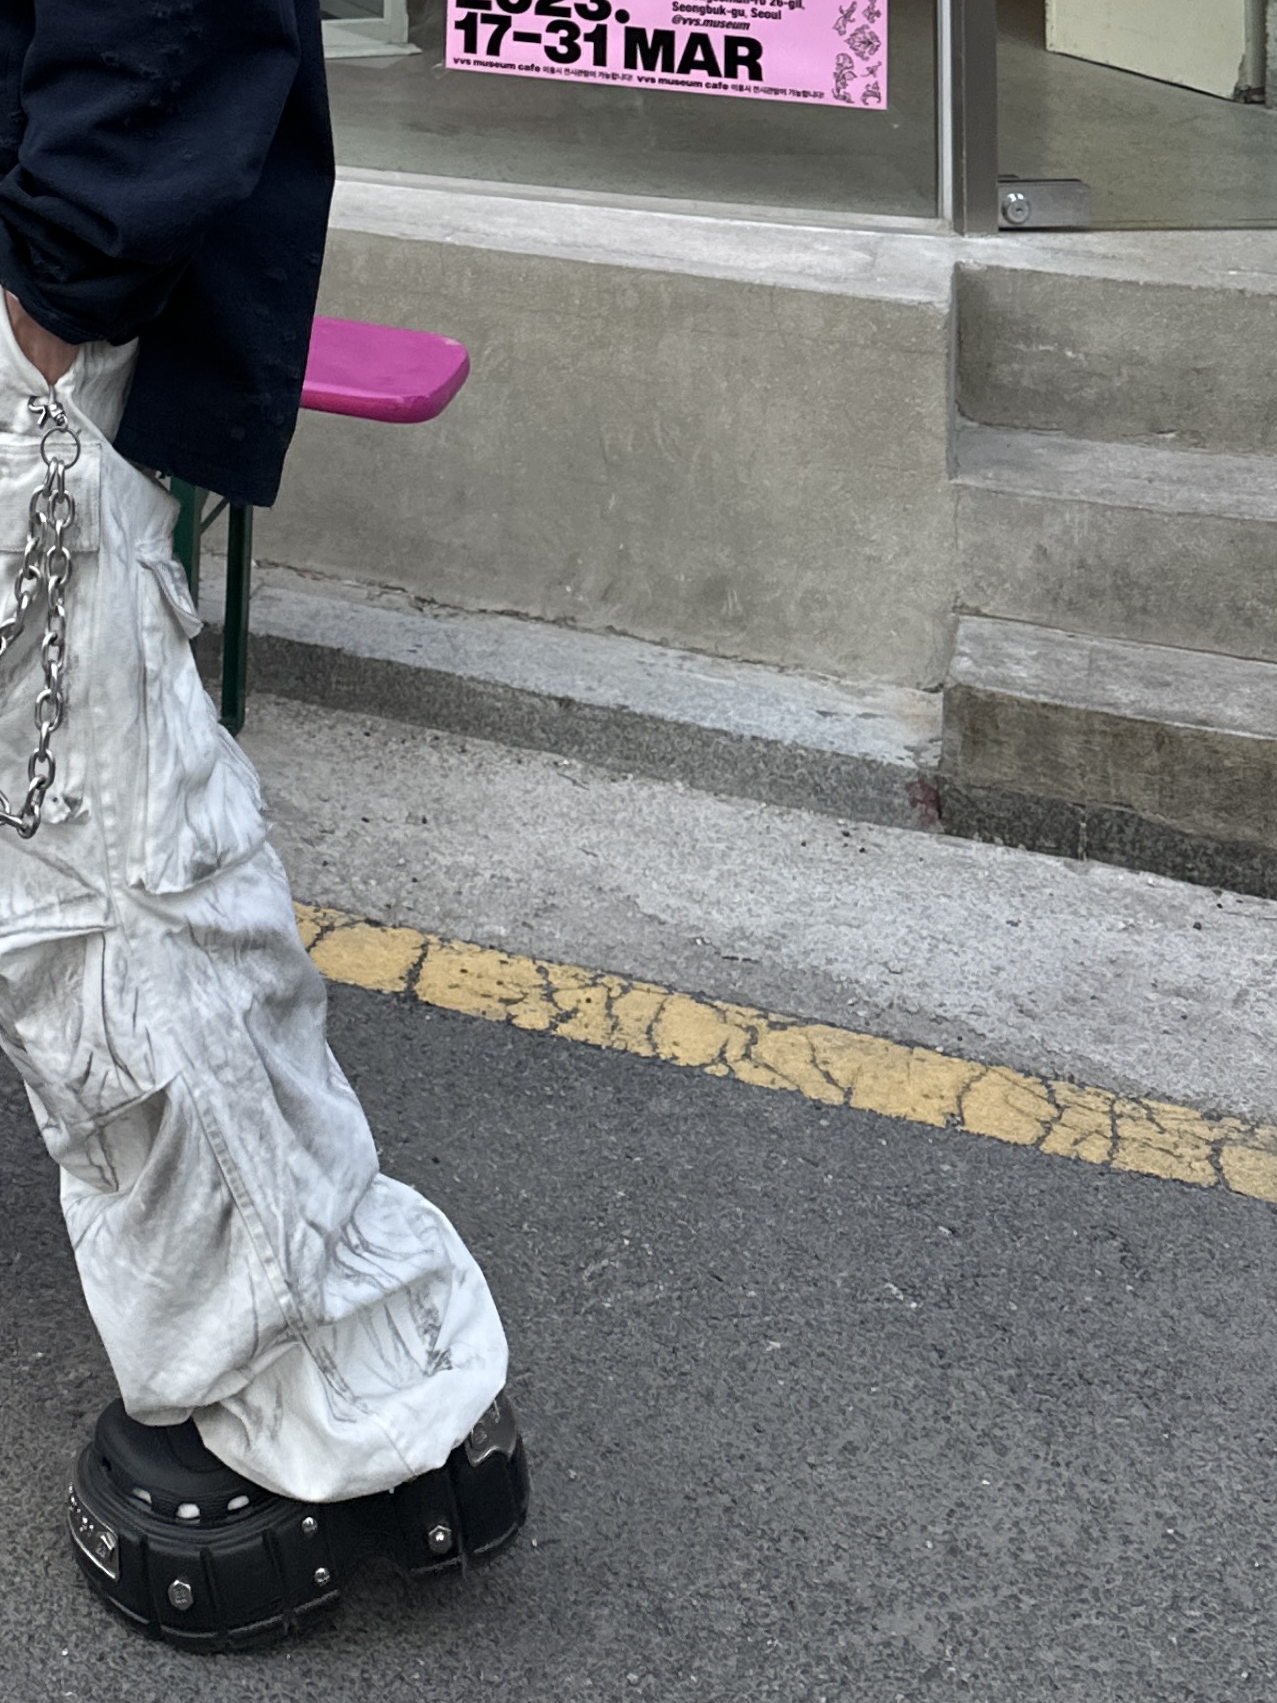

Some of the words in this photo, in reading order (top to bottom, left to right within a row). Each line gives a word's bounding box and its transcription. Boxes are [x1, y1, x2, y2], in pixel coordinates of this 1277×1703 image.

[672, 15, 750, 30] @vvs.museum
[751, 8, 782, 20] Seoul
[454, 11, 608, 67] 17-31
[624, 26, 763, 81] MAR
[453, 57, 472, 66] vvs
[473, 58, 516, 71] museum
[517, 62, 541, 73] cafe
[636, 75, 656, 84] vvs
[658, 77, 703, 89] museum
[705, 80, 729, 91] cafe
